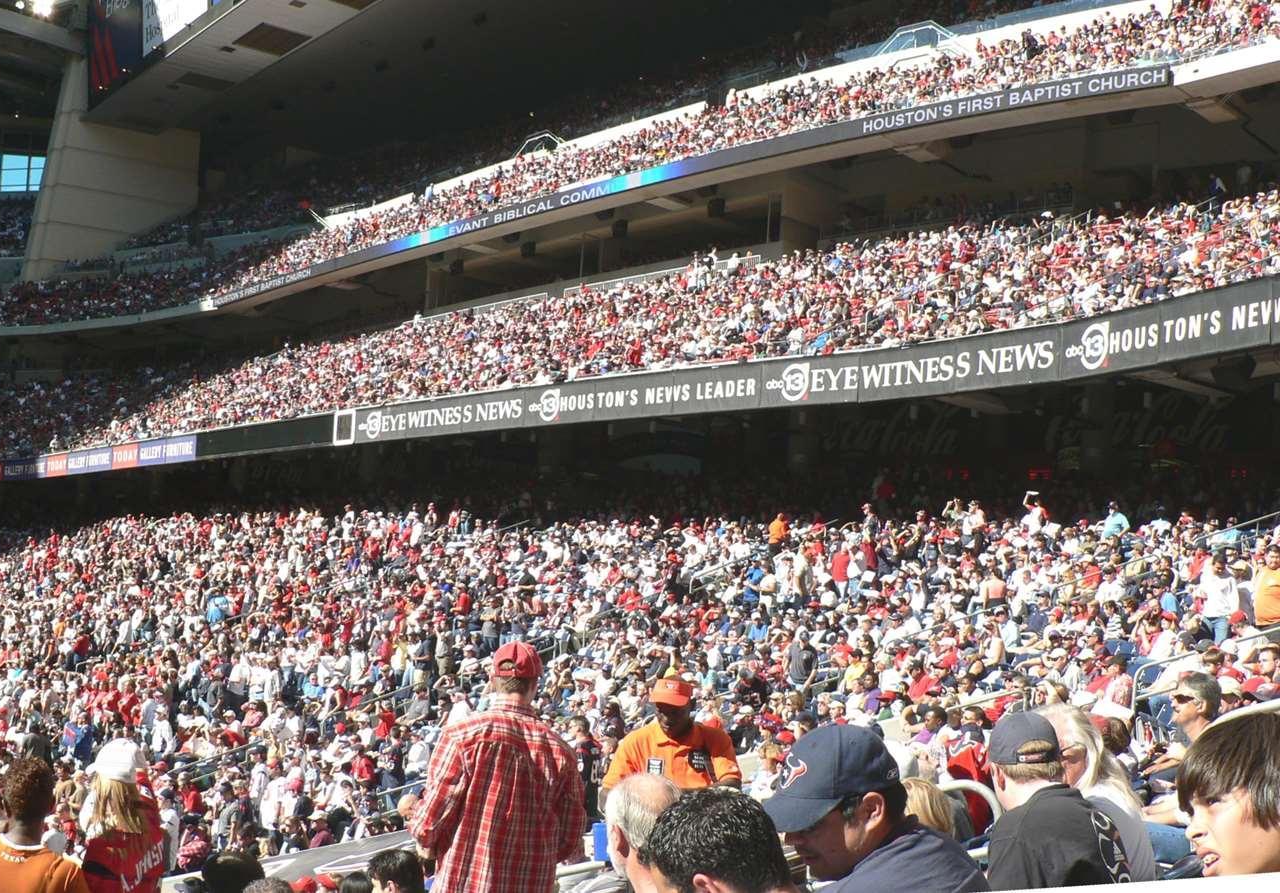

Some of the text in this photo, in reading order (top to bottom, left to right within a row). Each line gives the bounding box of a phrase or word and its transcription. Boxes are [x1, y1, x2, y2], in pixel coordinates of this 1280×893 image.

[862, 68, 1167, 134] HOUSTON'S FIRST BAPTIST CHURCH
[494, 200, 554, 224] BIBLICAL
[243, 286, 260, 298] FIRST
[261, 278, 284, 291] BAPTIST
[1065, 344, 1084, 358] abc
[1109, 310, 1221, 354] HOUSTON'S
[977, 340, 1054, 376] NEWS
[559, 389, 637, 413] HOUSTON'S
[696, 378, 756, 400] LEADER
[476, 399, 522, 422] NEWS
[113, 439, 193, 463] TODAY GALLERY FURNITURE
[4, 465, 24, 478] GALLERY
[48, 458, 67, 475] TODAY
[68, 454, 87, 471] GALLERY
